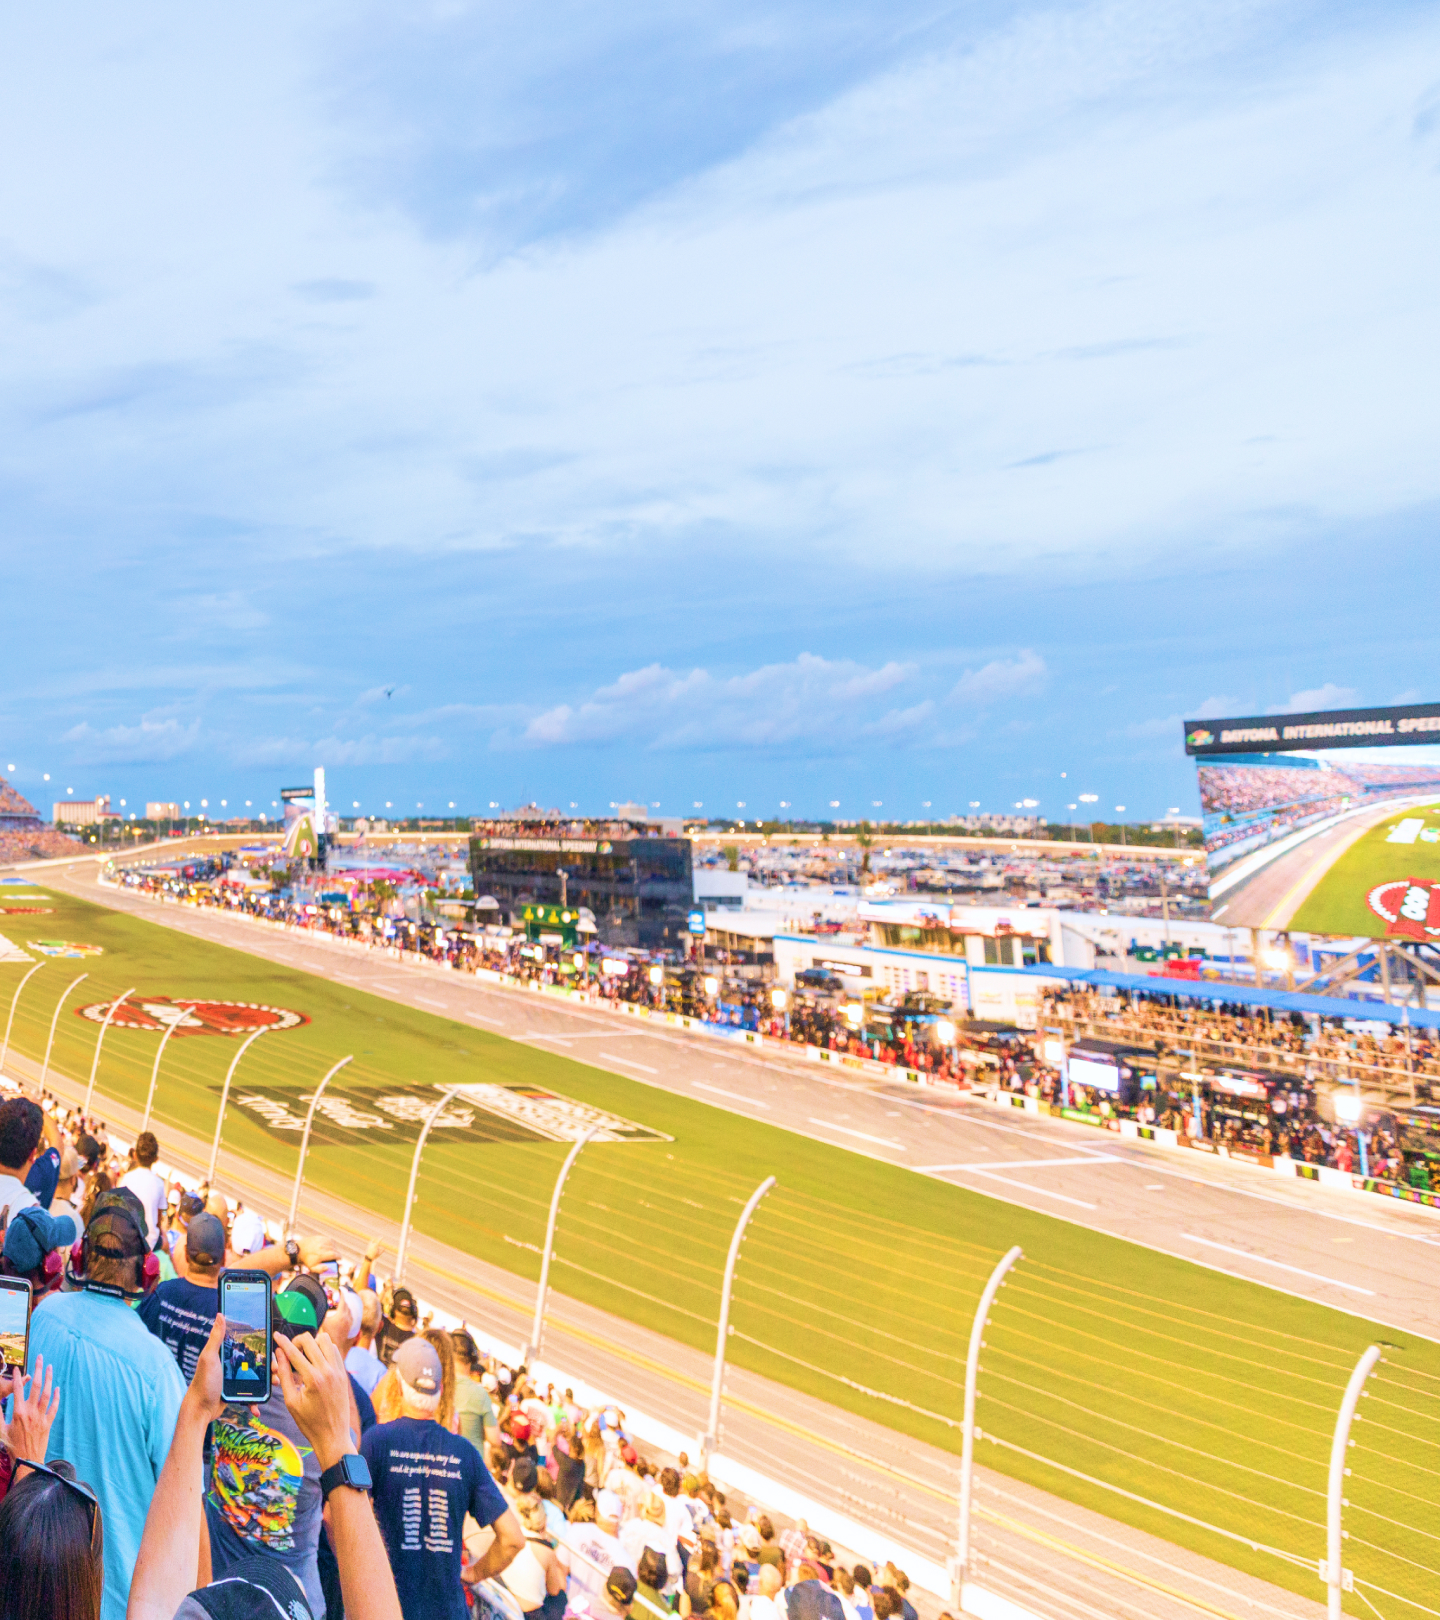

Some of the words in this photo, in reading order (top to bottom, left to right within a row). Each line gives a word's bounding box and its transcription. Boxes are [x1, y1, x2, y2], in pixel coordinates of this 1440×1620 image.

[1219, 727, 1279, 744] DAYTONA
[1282, 719, 1395, 741] INTERNATIONAL
[561, 840, 597, 853] SPEEDWAY
